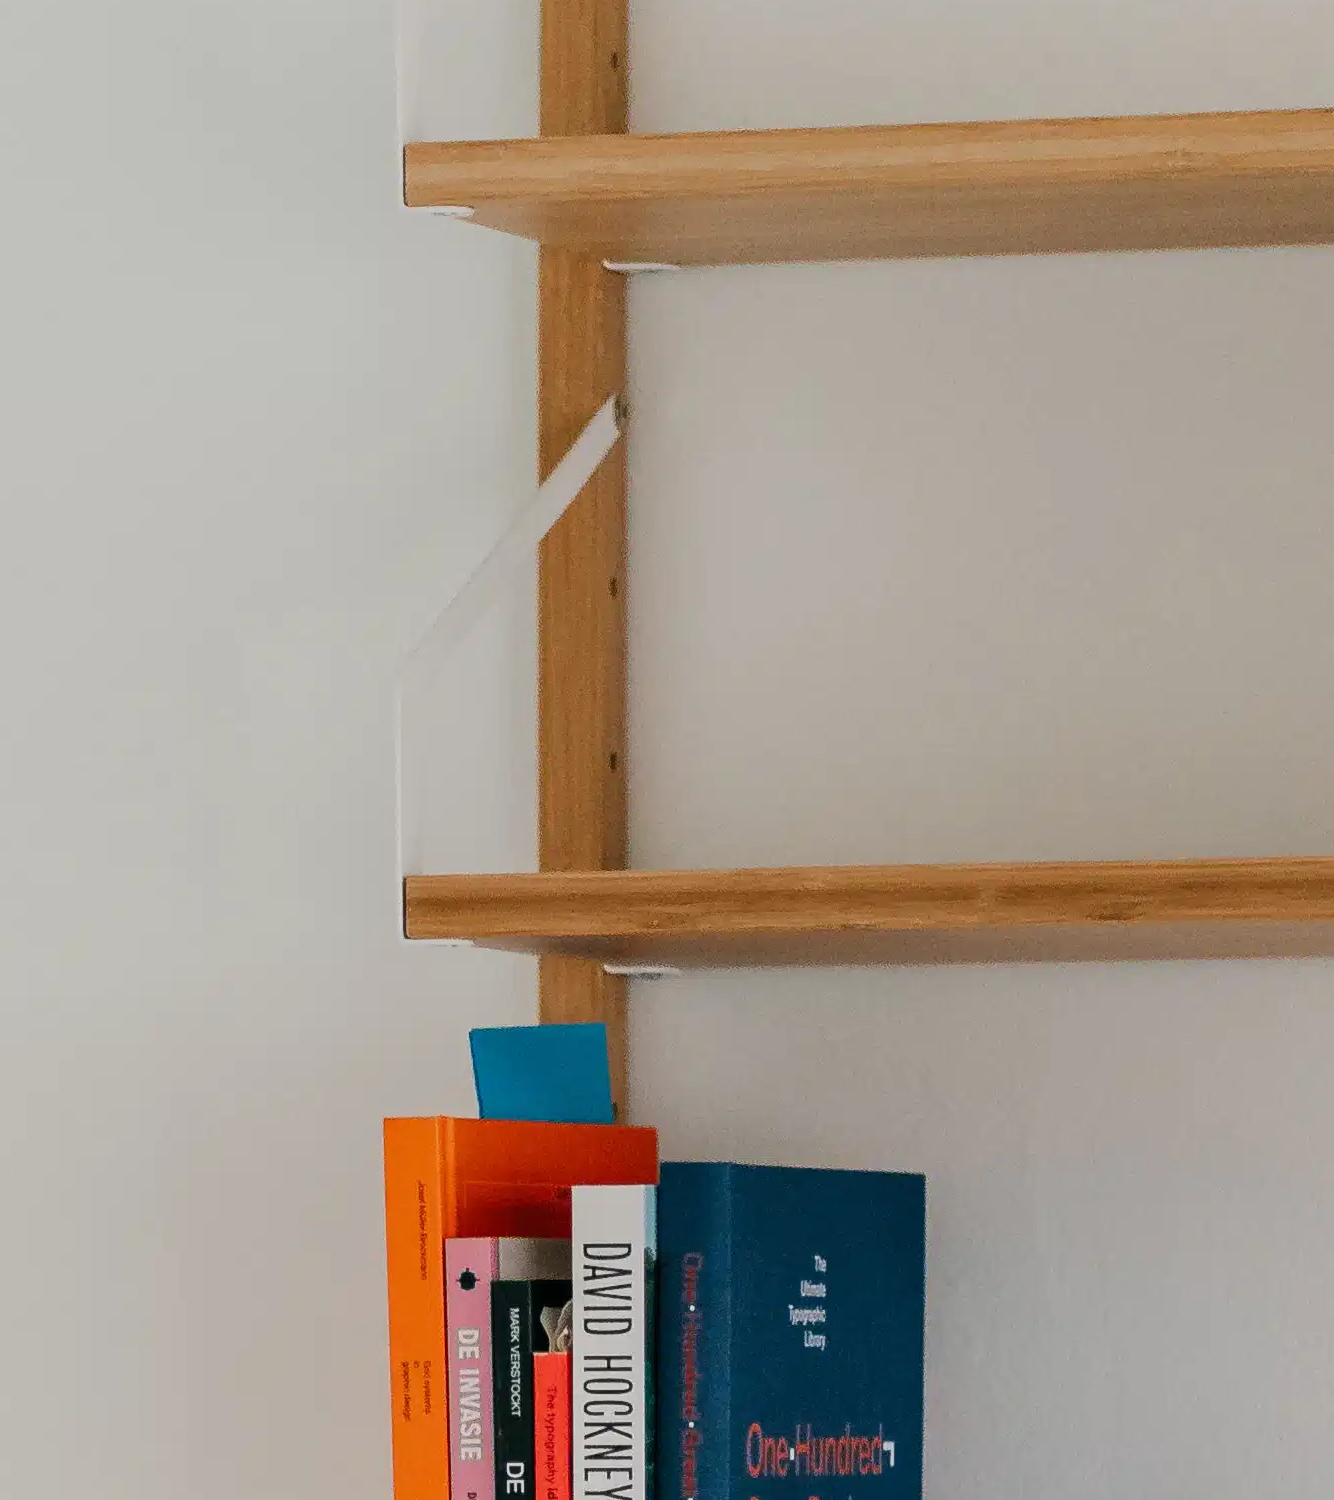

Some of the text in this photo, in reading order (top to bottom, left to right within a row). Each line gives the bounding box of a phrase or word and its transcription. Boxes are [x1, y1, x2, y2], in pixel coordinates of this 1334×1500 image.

[583, 1242, 633, 1336] DAVID
[814, 1255, 827, 1272] The
[458, 1327, 484, 1461] DE INVASIE
[509, 1307, 522, 1417] MARK VERSTOCKT
[547, 1386, 558, 1409] The
[506, 1462, 525, 1494] DE
[543, 1411, 559, 1485] typography
